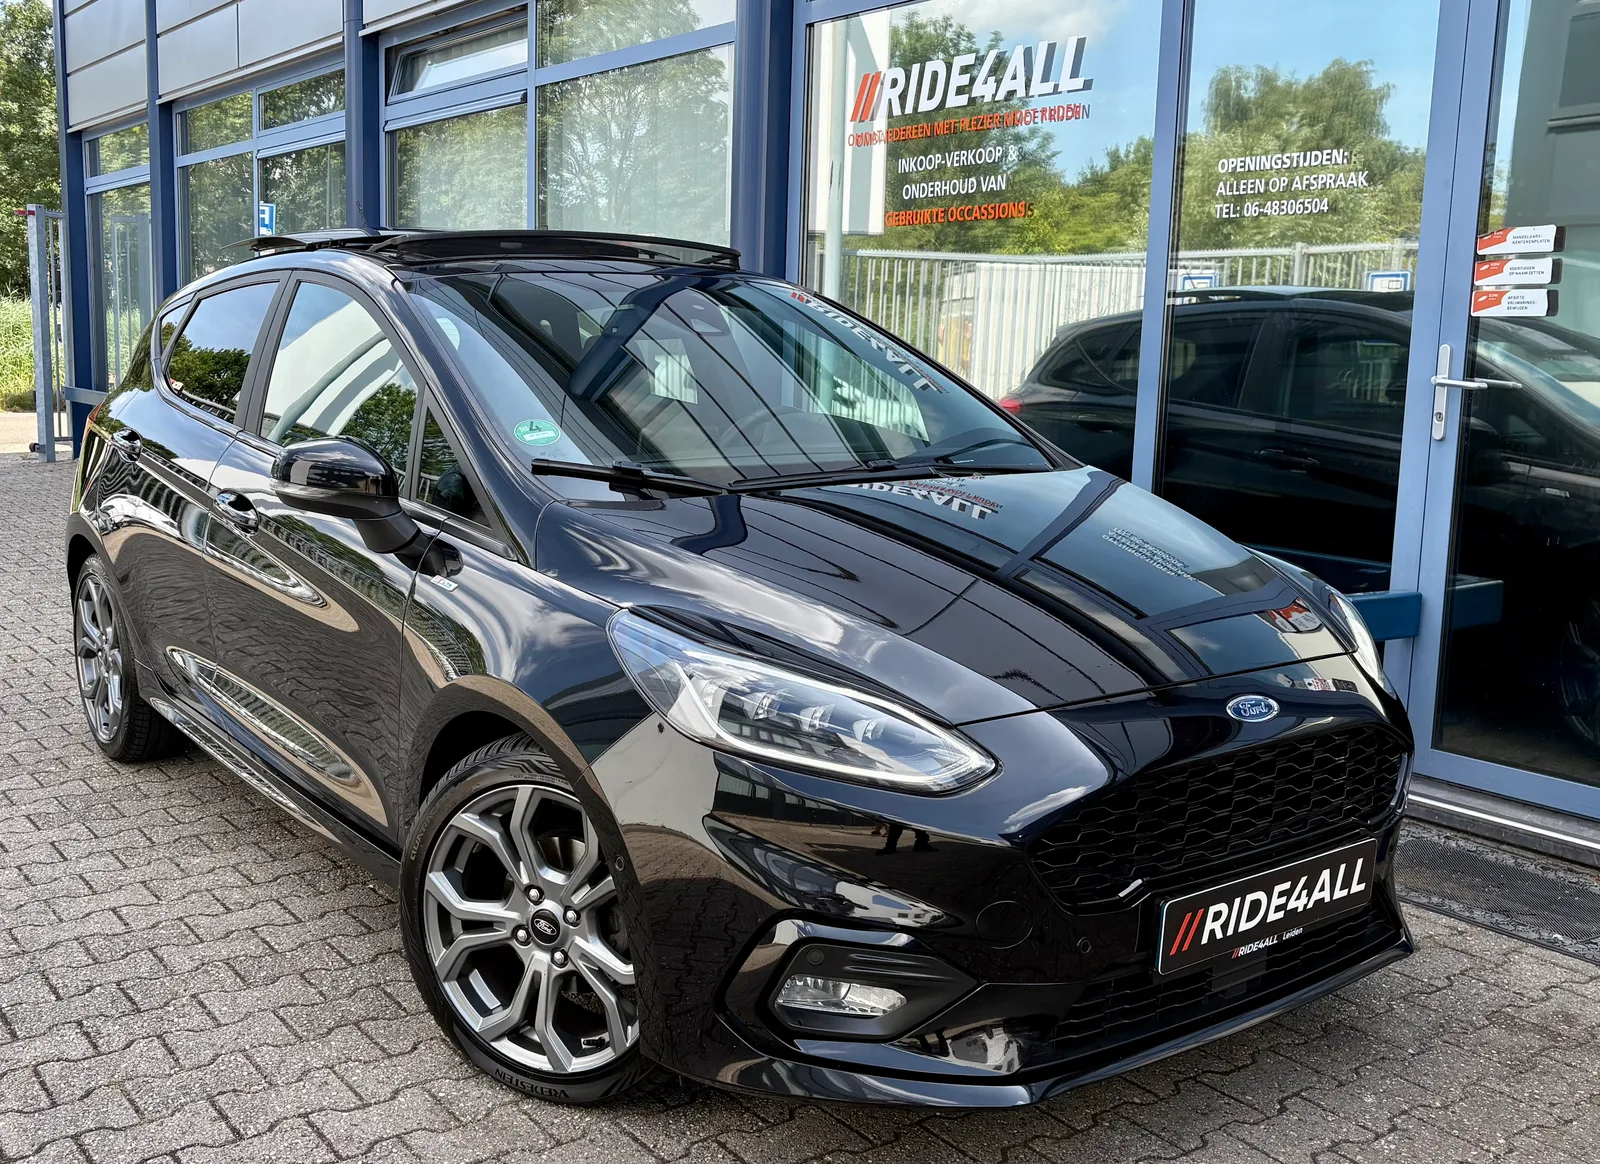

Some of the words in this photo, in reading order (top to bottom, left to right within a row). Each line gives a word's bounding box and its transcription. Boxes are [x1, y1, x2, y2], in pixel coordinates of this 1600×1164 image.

[885, 123, 931, 143] IEDEREEN
[933, 118, 956, 136] MET
[959, 113, 1000, 132] PLEZIER
[1003, 108, 1038, 128] MOET
[898, 147, 1003, 174] INKOOP-VERKOOP
[1008, 145, 1017, 161] &
[1218, 149, 1348, 174] OPENINGSTIJDEN:
[902, 177, 976, 200] ONDERHOUD
[980, 174, 1006, 193] VAN
[1216, 178, 1265, 196] ALLEEN
[1269, 177, 1288, 193] OP
[1291, 171, 1369, 192] AFSPRAAK
[885, 206, 945, 227] GEBRUIKTE
[948, 201, 1026, 222] OCCASSIONS
[1215, 203, 1240, 218] TEL:
[1244, 198, 1329, 217] 06-48306504
[1239, 700, 1269, 717] Ford
[1282, 927, 1303, 940] Leiden
[494, 1067, 570, 1099] VREDESTEIN
